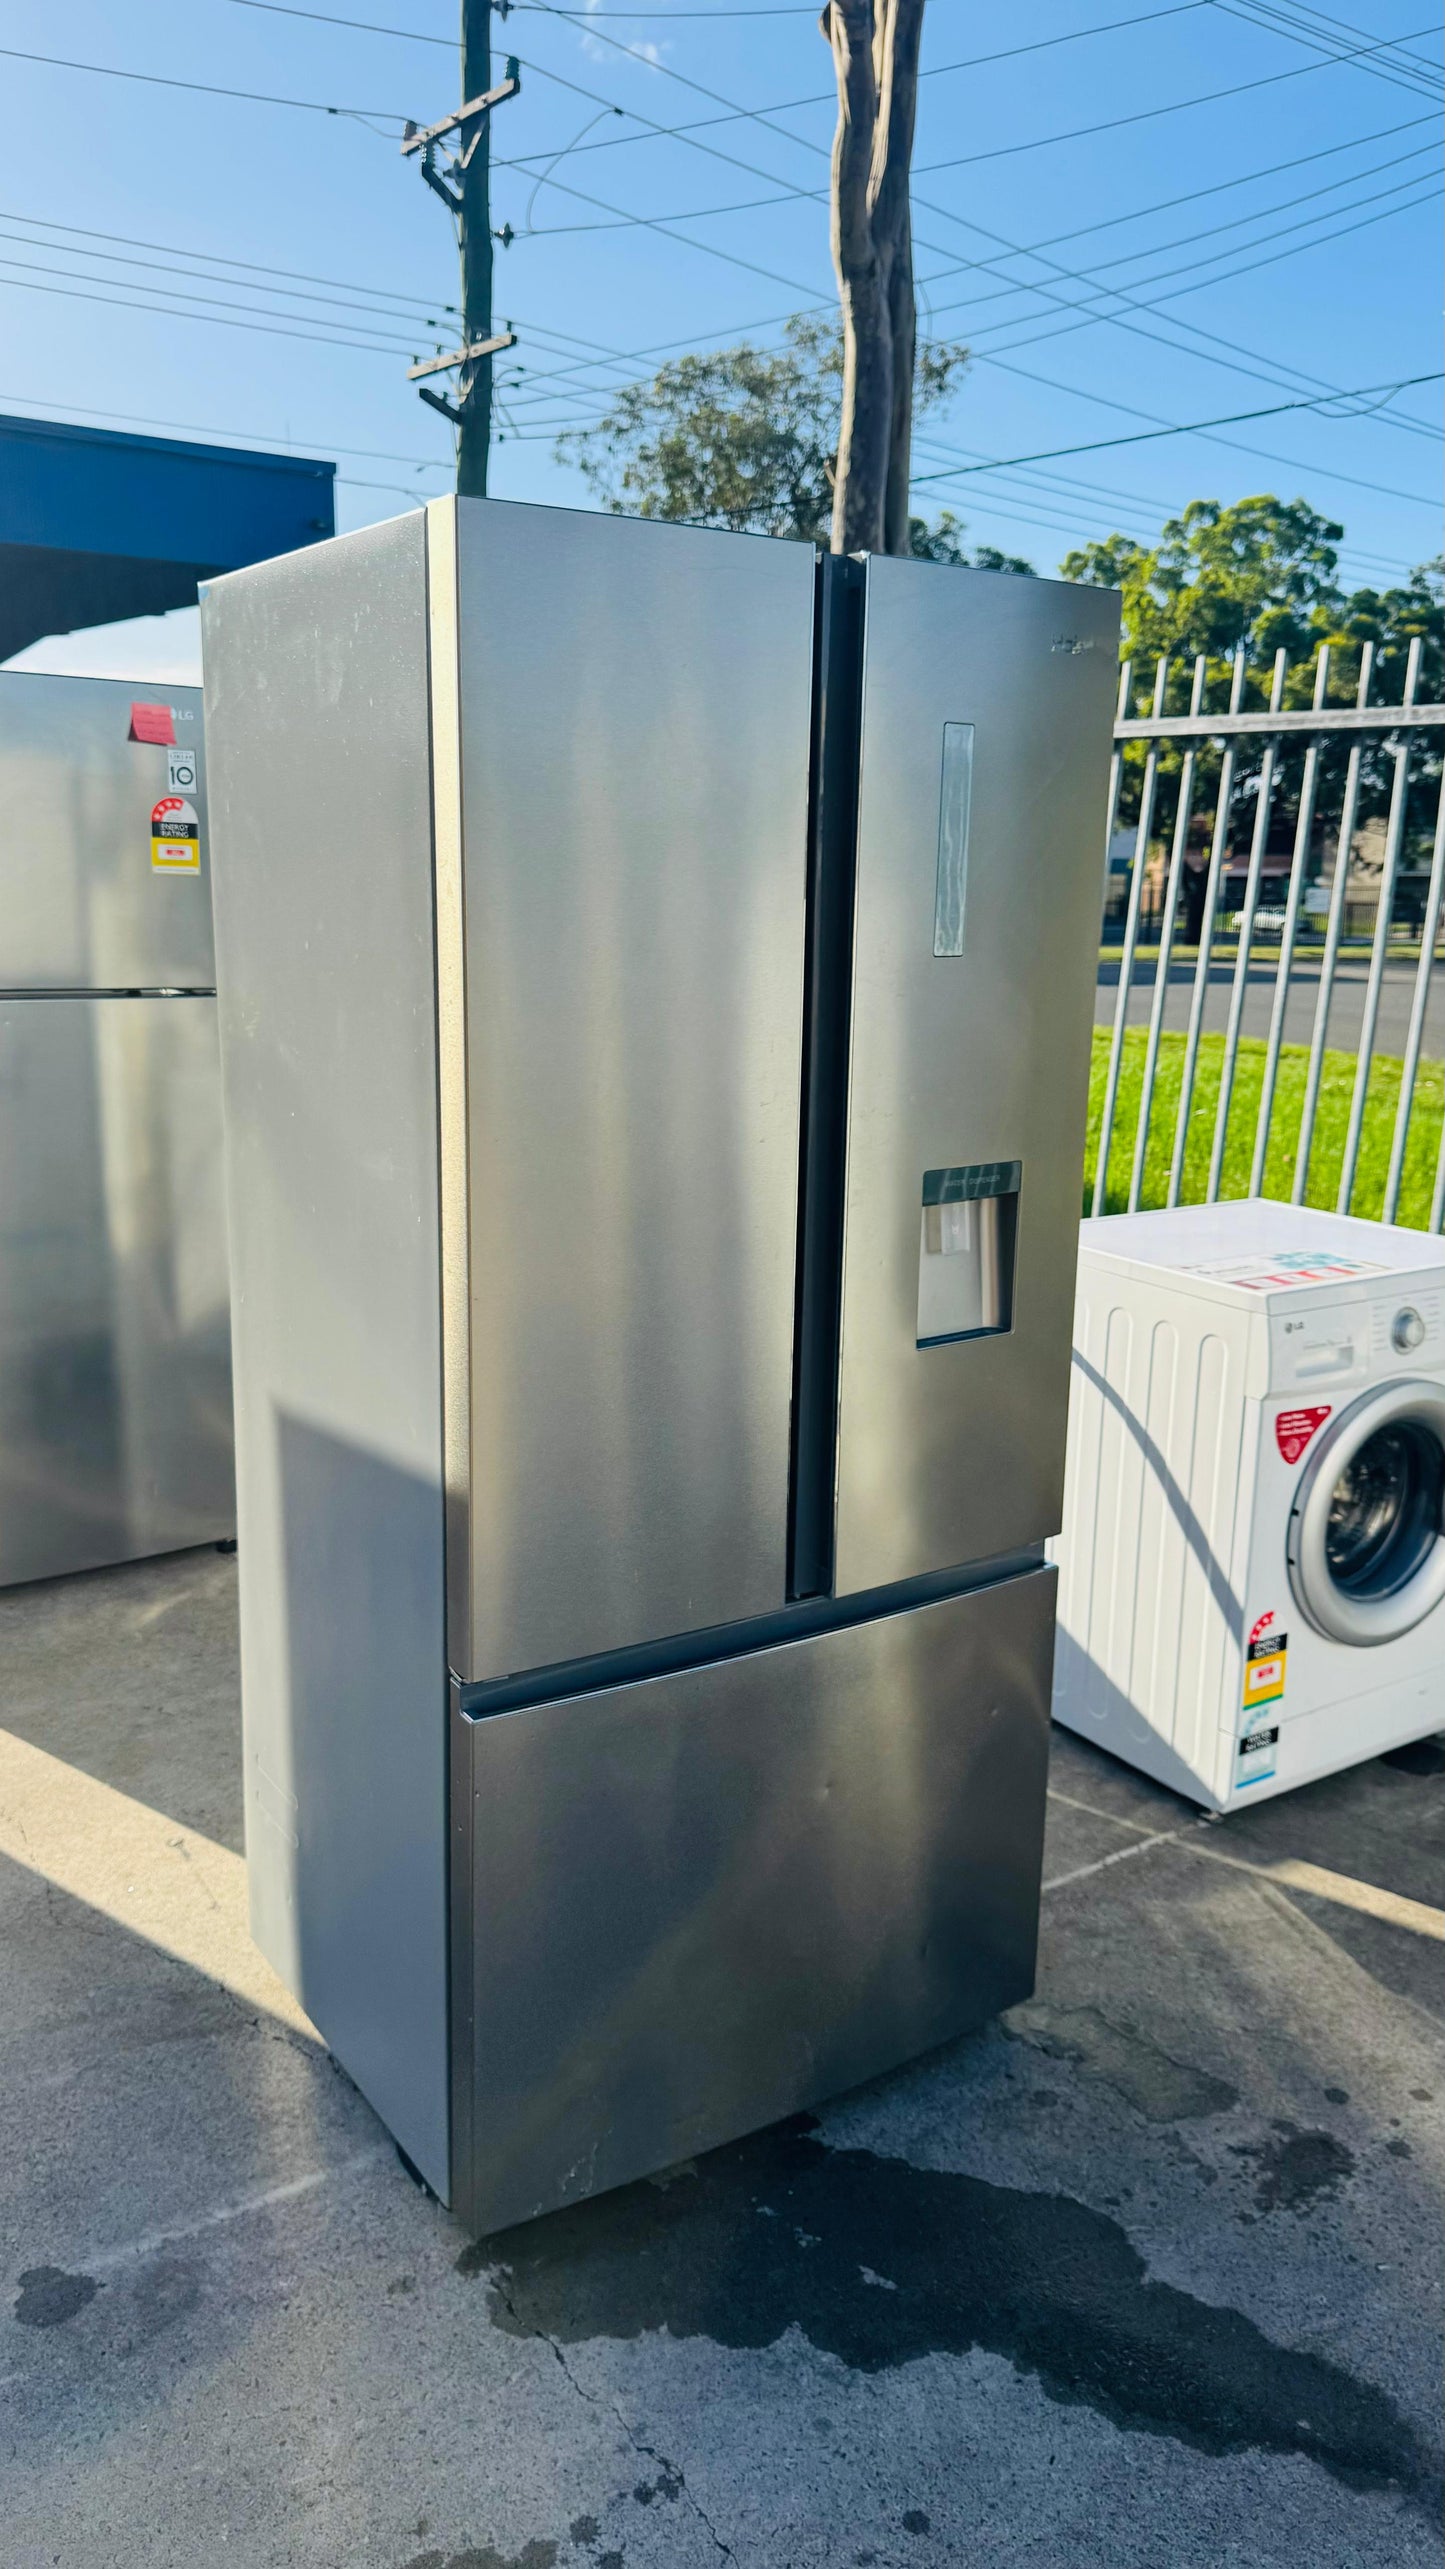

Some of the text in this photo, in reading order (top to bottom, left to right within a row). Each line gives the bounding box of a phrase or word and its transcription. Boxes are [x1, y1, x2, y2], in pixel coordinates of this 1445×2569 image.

[178, 709, 194, 721] LG
[170, 766, 194, 785] 10
[160, 823, 189, 831] ENERGY
[160, 830, 189, 839] RATING
